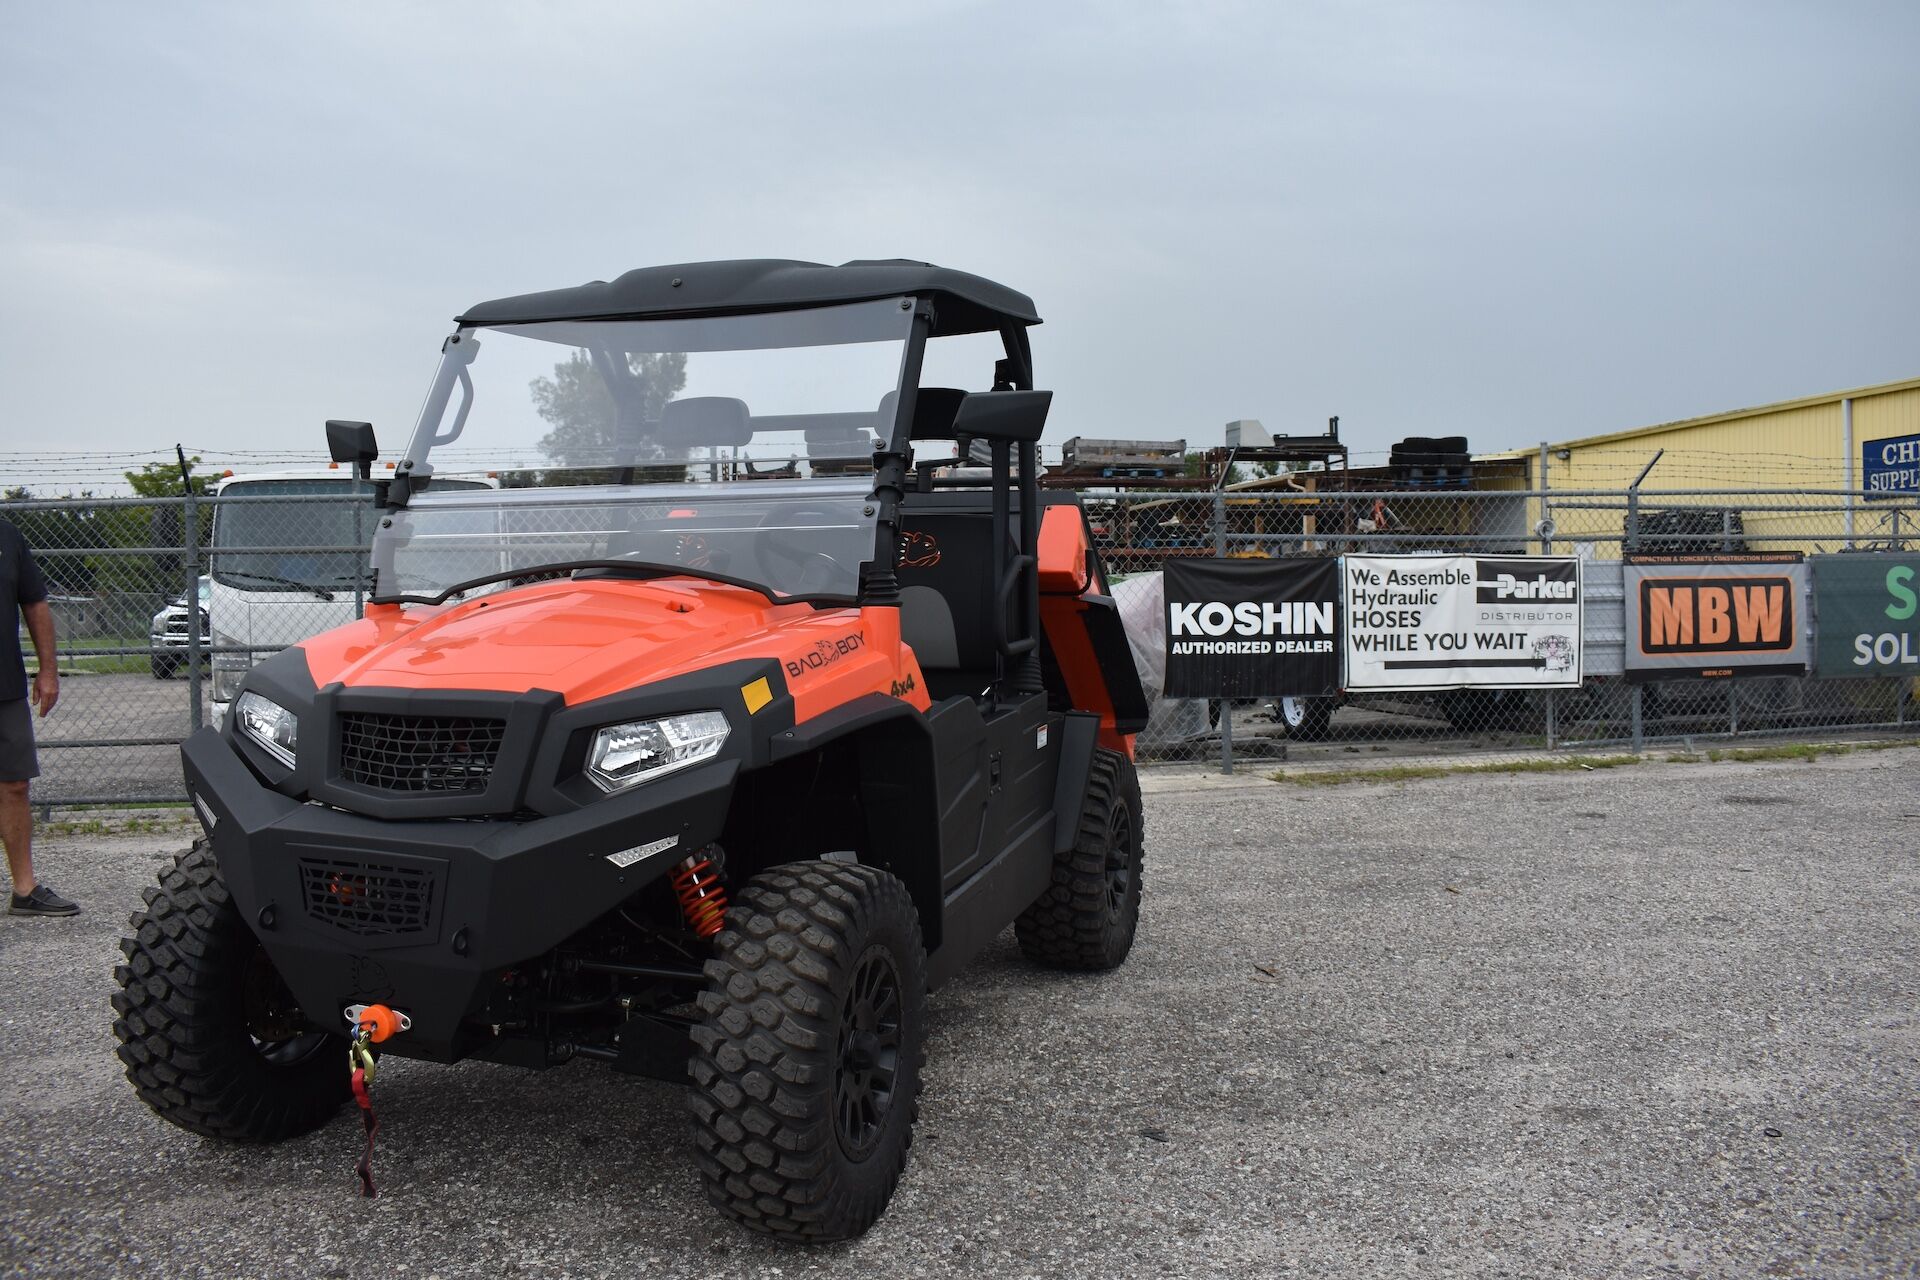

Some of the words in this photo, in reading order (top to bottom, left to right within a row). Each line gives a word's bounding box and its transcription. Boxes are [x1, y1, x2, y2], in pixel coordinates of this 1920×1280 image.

[1882, 440, 1920, 466] CH
[1870, 469, 1920, 491] SUPPL
[1630, 555, 1672, 563] COMPACTION
[1713, 554, 1761, 562] CONSTRUCTION
[1761, 554, 1797, 562] EQUIPMENT
[1351, 569, 1381, 586] We
[1386, 568, 1471, 586] Assemble
[1497, 573, 1576, 599] Parker
[1352, 589, 1438, 610] Hydraulic
[1885, 565, 1920, 620] S
[1170, 601, 1334, 636] KOSHIN
[1352, 610, 1421, 629] HOSES
[1481, 611, 1573, 621] DISTRIBUTOR
[1650, 586, 1785, 646] MBW
[1172, 641, 1272, 655] AUTHORIZED
[1275, 640, 1334, 653] DEALER
[1351, 633, 1418, 652] WHILE
[1424, 633, 1467, 651] YOU
[1474, 632, 1528, 650] WAIT
[786, 651, 823, 677] BAD
[836, 630, 865, 655] BOY
[1702, 669, 1733, 677] MBW.COM
[890, 672, 915, 698] 4x4
